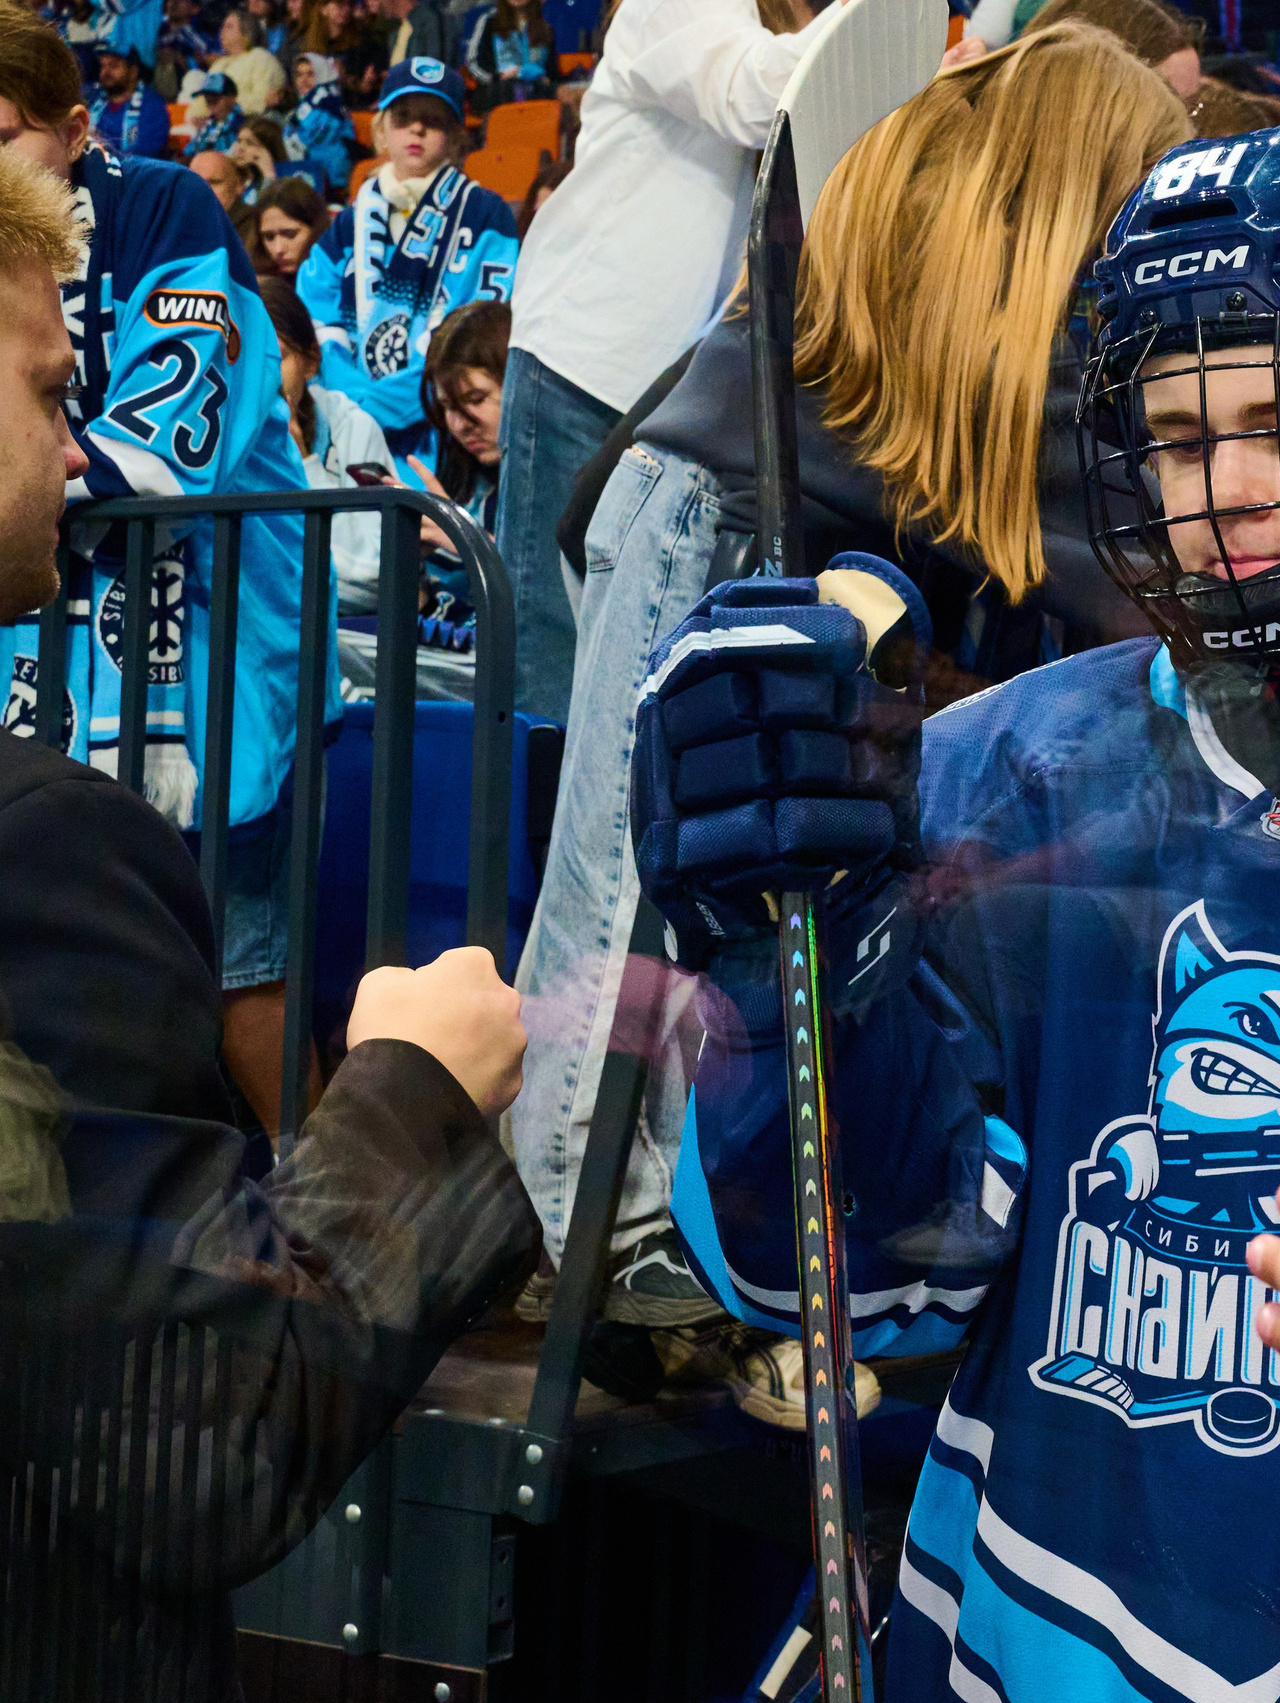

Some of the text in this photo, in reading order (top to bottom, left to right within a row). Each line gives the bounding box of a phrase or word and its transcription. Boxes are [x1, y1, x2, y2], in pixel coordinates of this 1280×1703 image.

[1152, 143, 1250, 200] 84
[1134, 245, 1250, 285] CCM
[103, 338, 229, 471] 23
